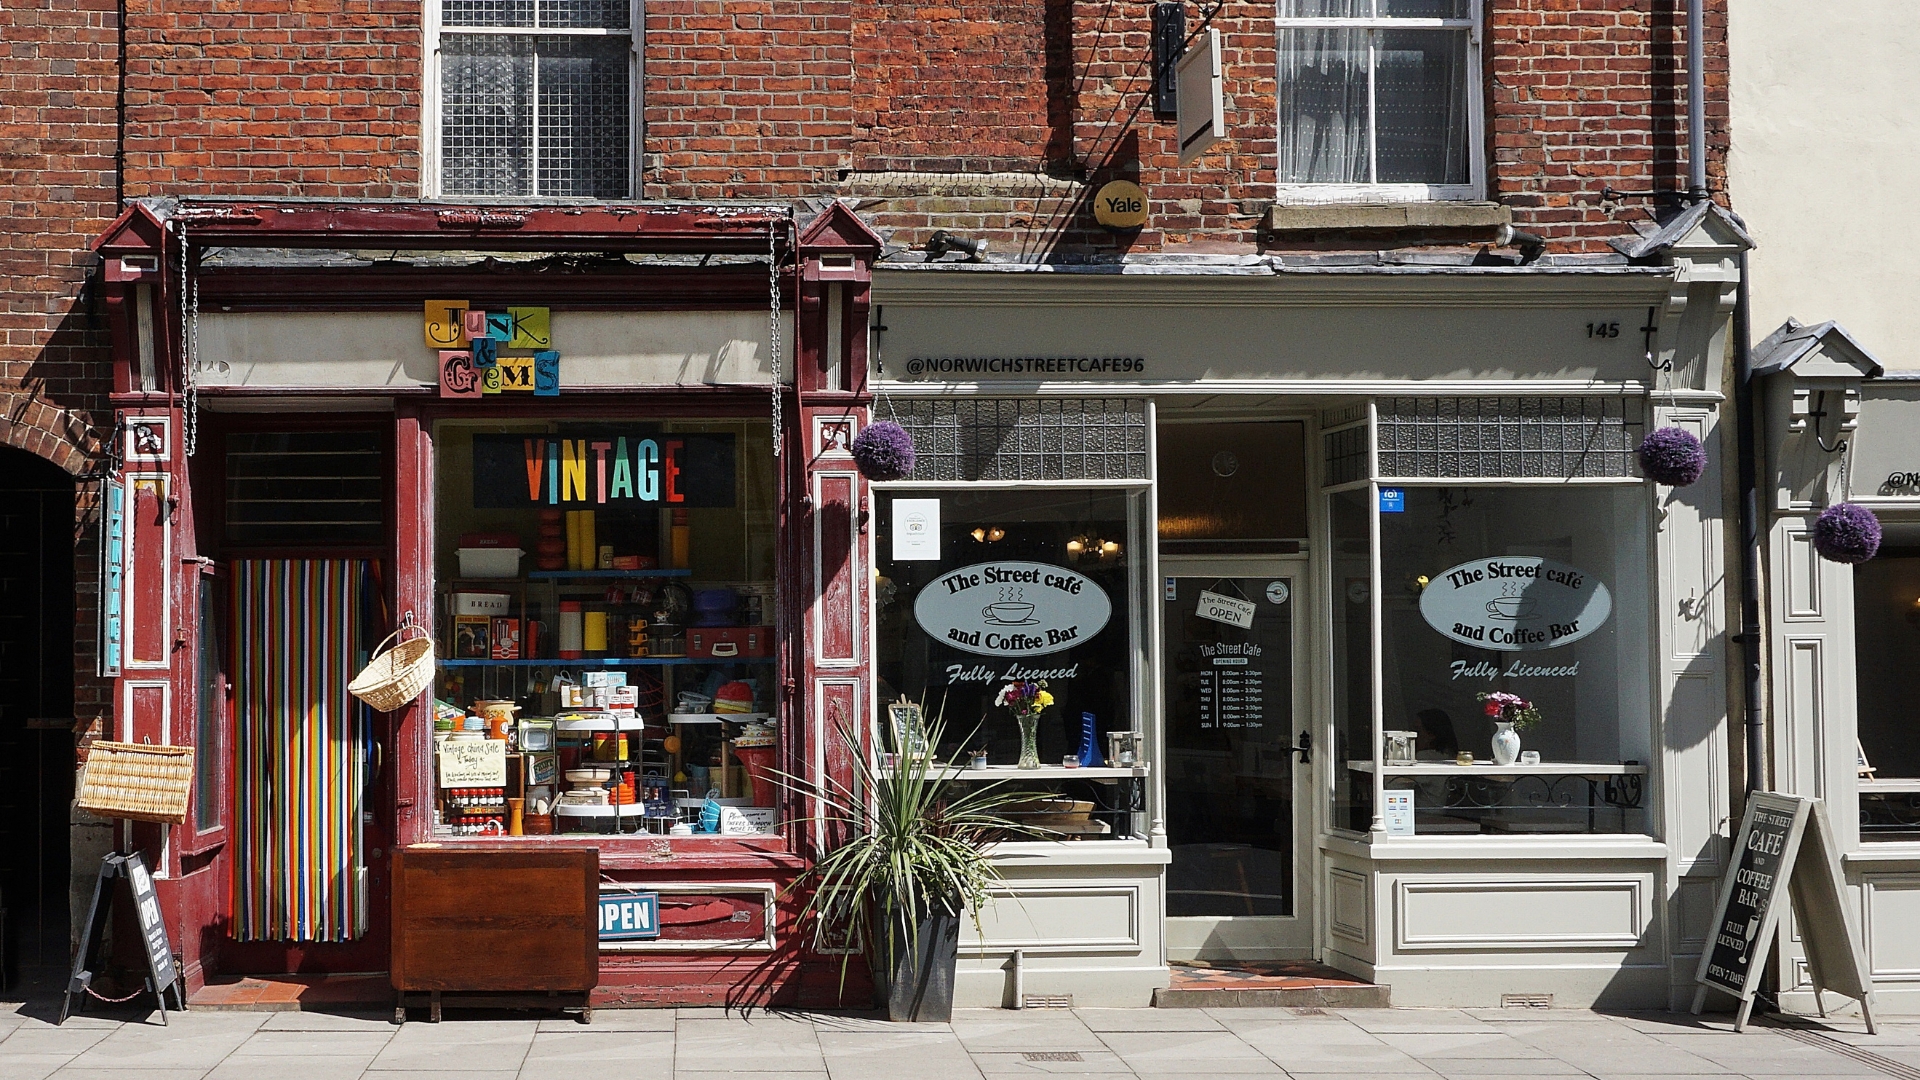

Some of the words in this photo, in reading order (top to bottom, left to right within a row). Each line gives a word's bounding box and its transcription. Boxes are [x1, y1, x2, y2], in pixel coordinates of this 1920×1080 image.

[1105, 197, 1142, 213] Yale
[1586, 323, 1620, 339] 145
[475, 338, 496, 366] &
[906, 357, 1145, 376] @NORWICHSTREETCAFE96
[524, 436, 685, 504] VINTAGE
[942, 573, 981, 595] The
[983, 566, 1041, 585] Street
[1044, 573, 1085, 596] café
[1446, 569, 1484, 591] The
[1487, 561, 1542, 580] Street
[1546, 568, 1585, 590] café
[471, 600, 502, 608] BREAD
[1202, 596, 1216, 605] The
[1217, 597, 1237, 608] Street
[1209, 606, 1242, 623] OPEN
[947, 626, 982, 648] and
[985, 632, 1044, 651] Coffee
[1045, 625, 1079, 647] Bar
[1452, 621, 1486, 641] and
[1488, 627, 1546, 645] Coffee
[1548, 619, 1580, 641] Bar
[1199, 644, 1216, 658] The
[1216, 642, 1242, 655] Street
[1242, 642, 1262, 657] Cafe
[945, 662, 996, 686] Fully
[1000, 662, 1079, 682] Licenced
[1450, 659, 1499, 682] Fully
[1503, 659, 1580, 678] Licenced
[443, 743, 465, 761] Vintage
[485, 742, 500, 755] Sale
[1754, 811, 1768, 823] THE
[1768, 815, 1793, 828] STREET
[1748, 830, 1785, 856] CAFÉ
[1753, 857, 1766, 866] AND
[1736, 868, 1773, 891] COFFEE
[1737, 888, 1758, 908] BAR
[1726, 920, 1745, 934] FULLY
[1717, 933, 1745, 951] LICENCED
[1708, 963, 1725, 978] OPEN
[1725, 968, 1730, 981] 7
[1729, 970, 1745, 986] DAYS
